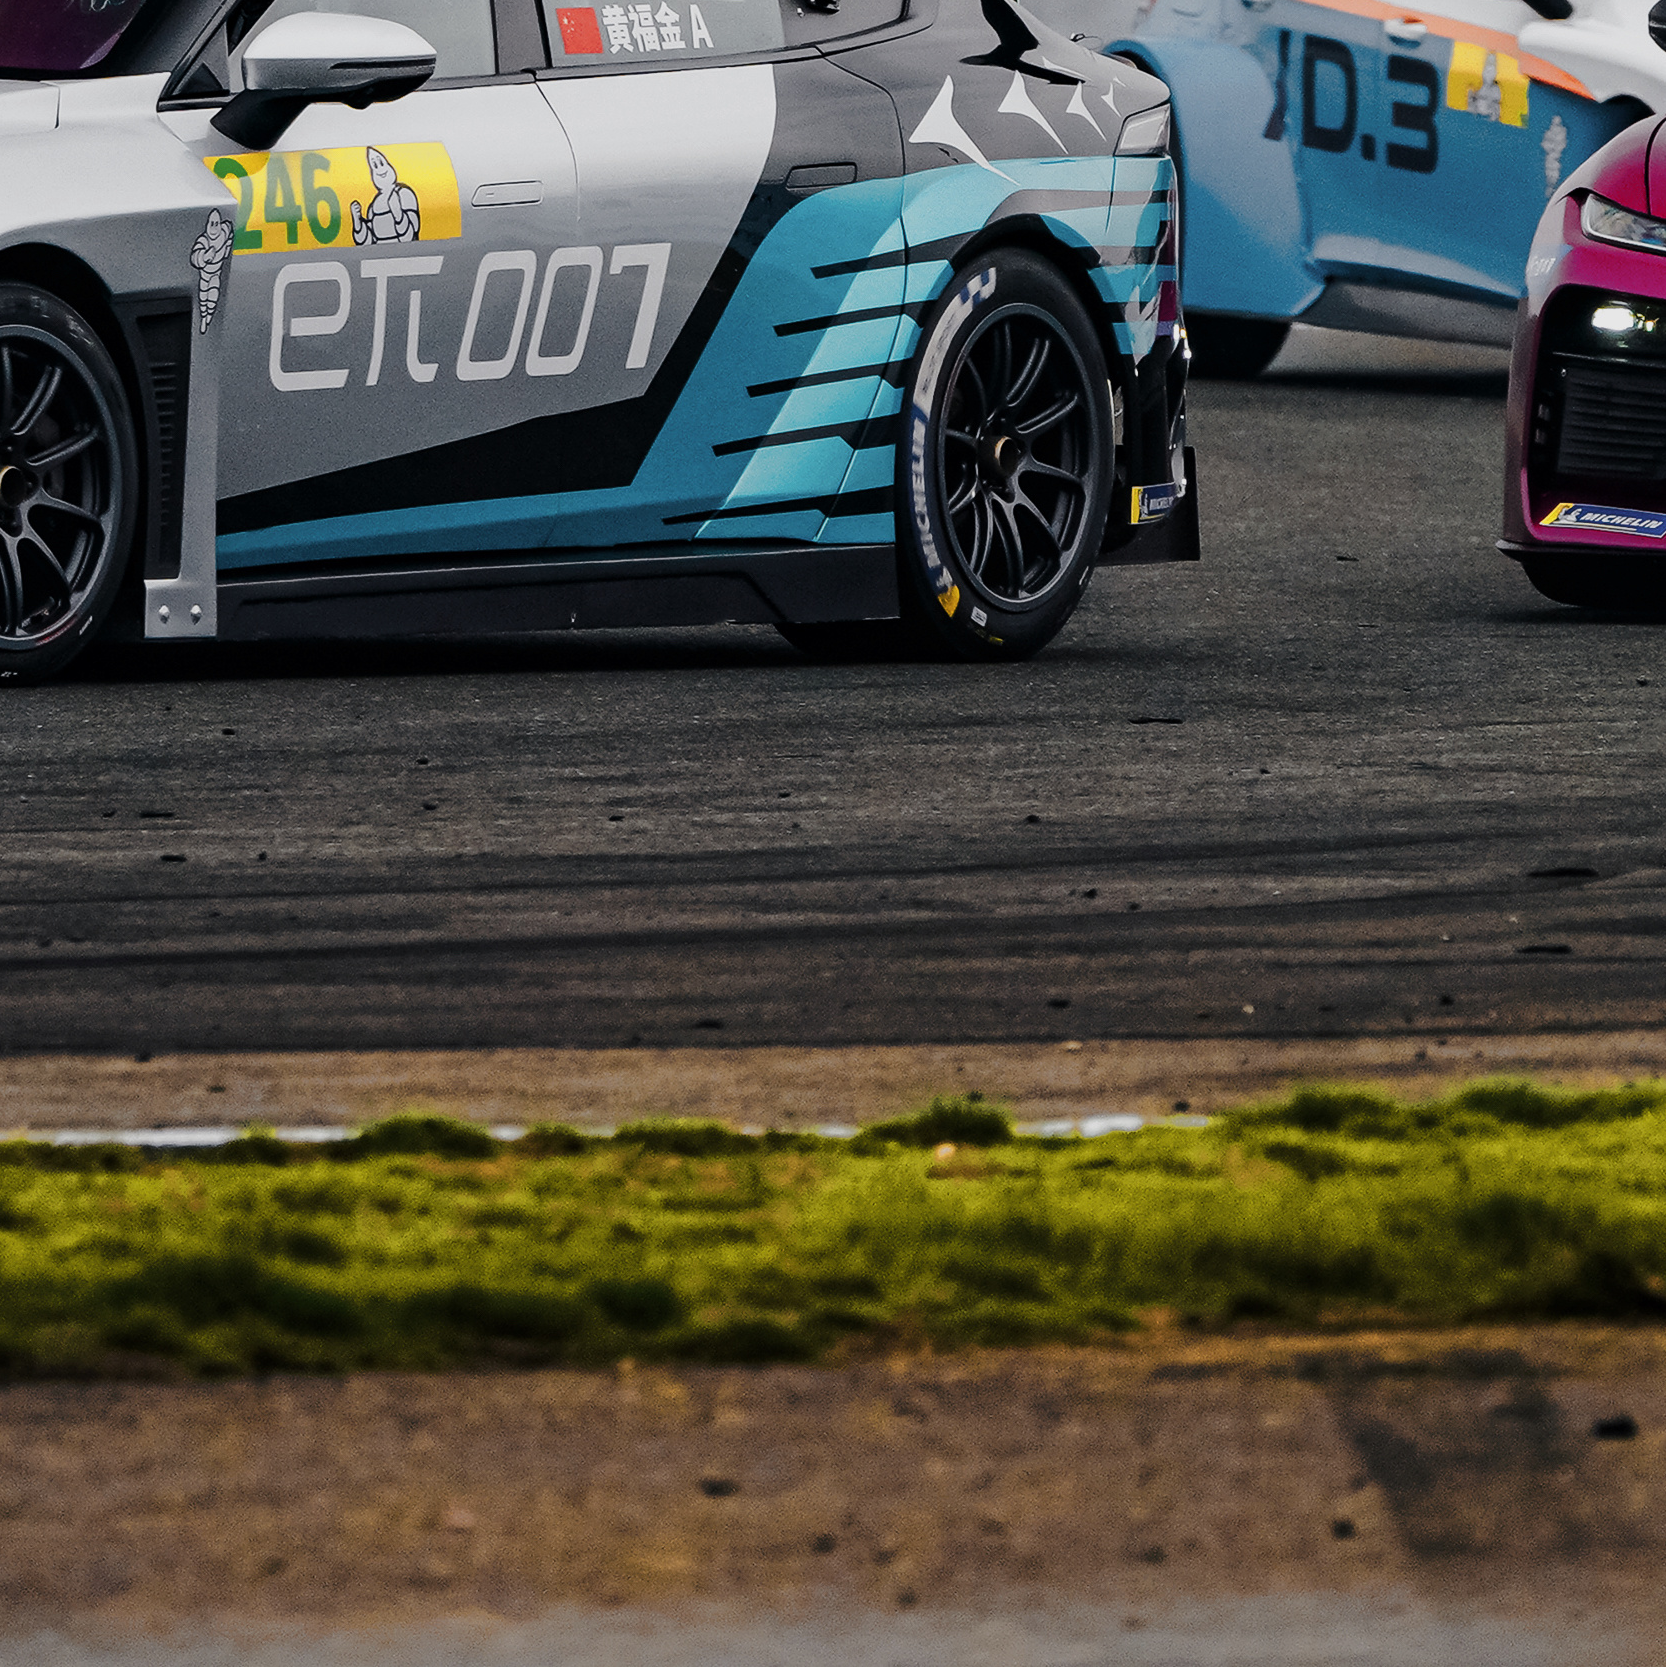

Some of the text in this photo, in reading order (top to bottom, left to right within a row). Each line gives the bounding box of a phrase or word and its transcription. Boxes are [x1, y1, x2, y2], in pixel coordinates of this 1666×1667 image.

[601, 0, 715, 55] 黄福金 A
[1263, 29, 1440, 175] ID.3
[213, 151, 343, 251] 246
[911, 417, 941, 569] MICHELIN
[1580, 512, 1664, 530] MICHELIN
